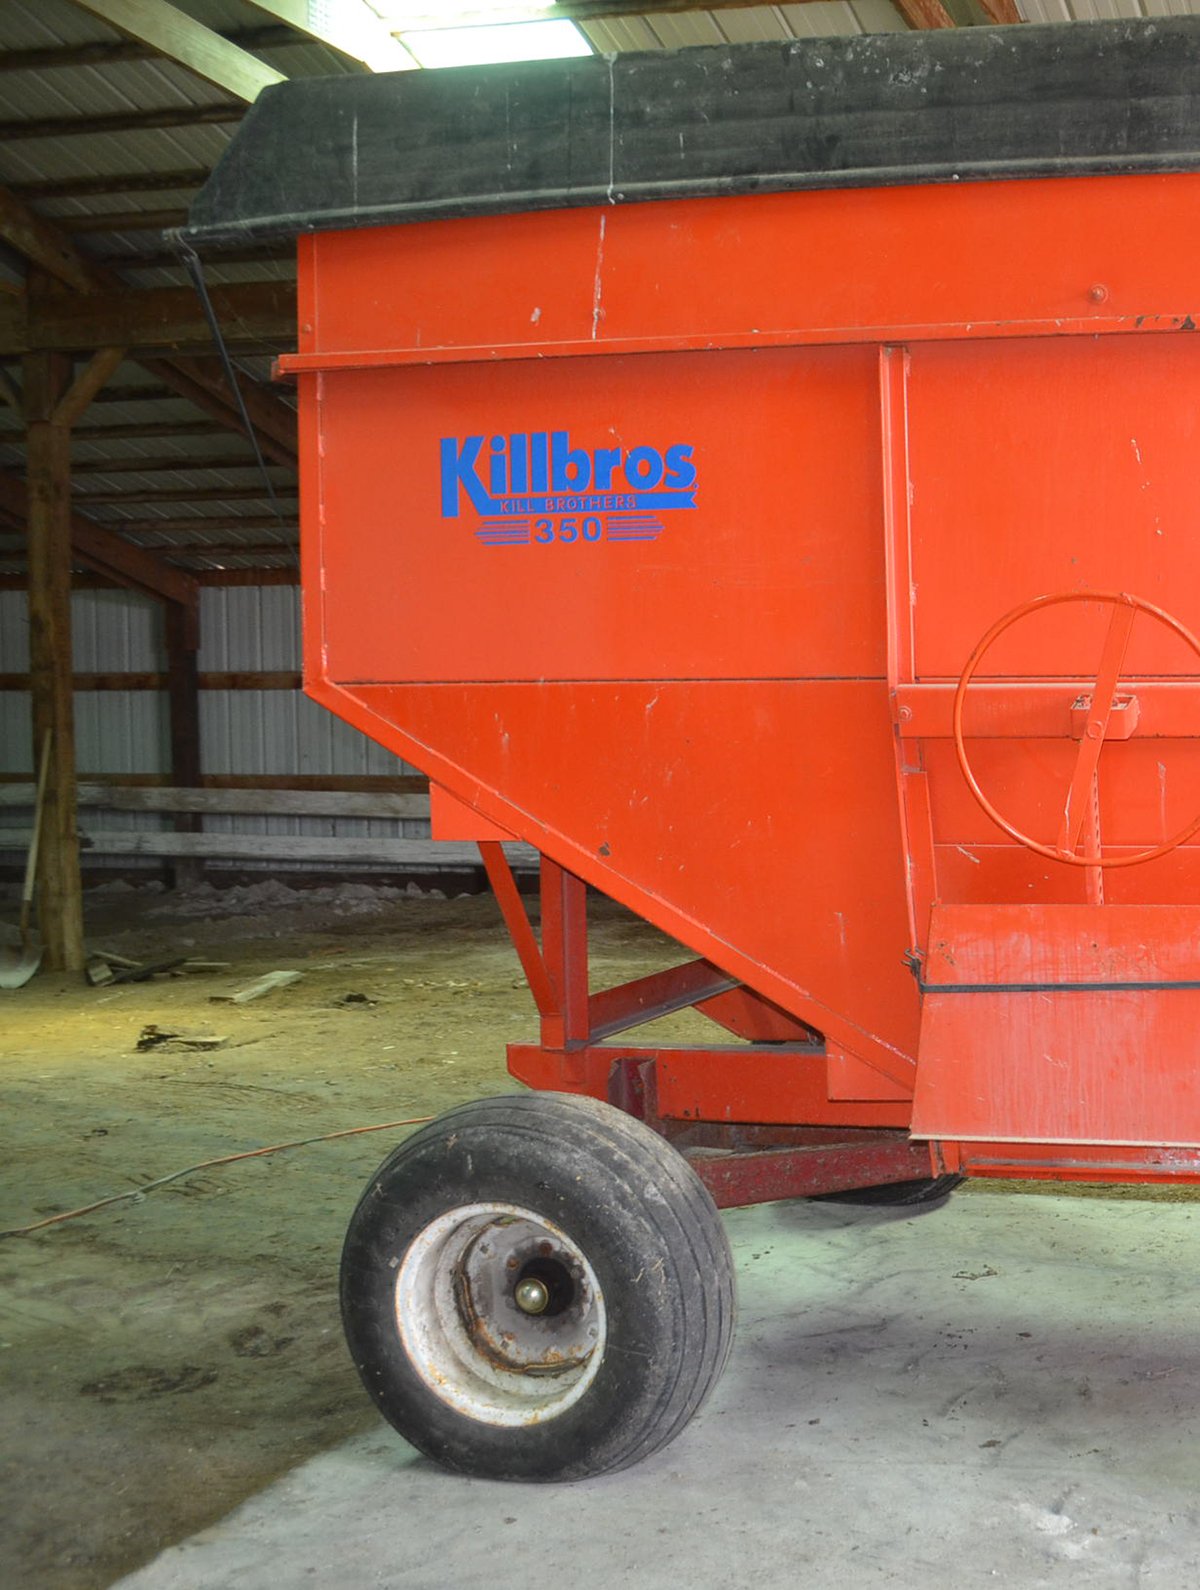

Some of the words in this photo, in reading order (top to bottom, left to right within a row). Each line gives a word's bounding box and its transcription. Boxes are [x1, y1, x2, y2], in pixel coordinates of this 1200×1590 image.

[440, 431, 697, 517] Killbros
[500, 499, 534, 513] KILL
[545, 495, 637, 511] BROTHERS
[534, 516, 602, 543] 350
